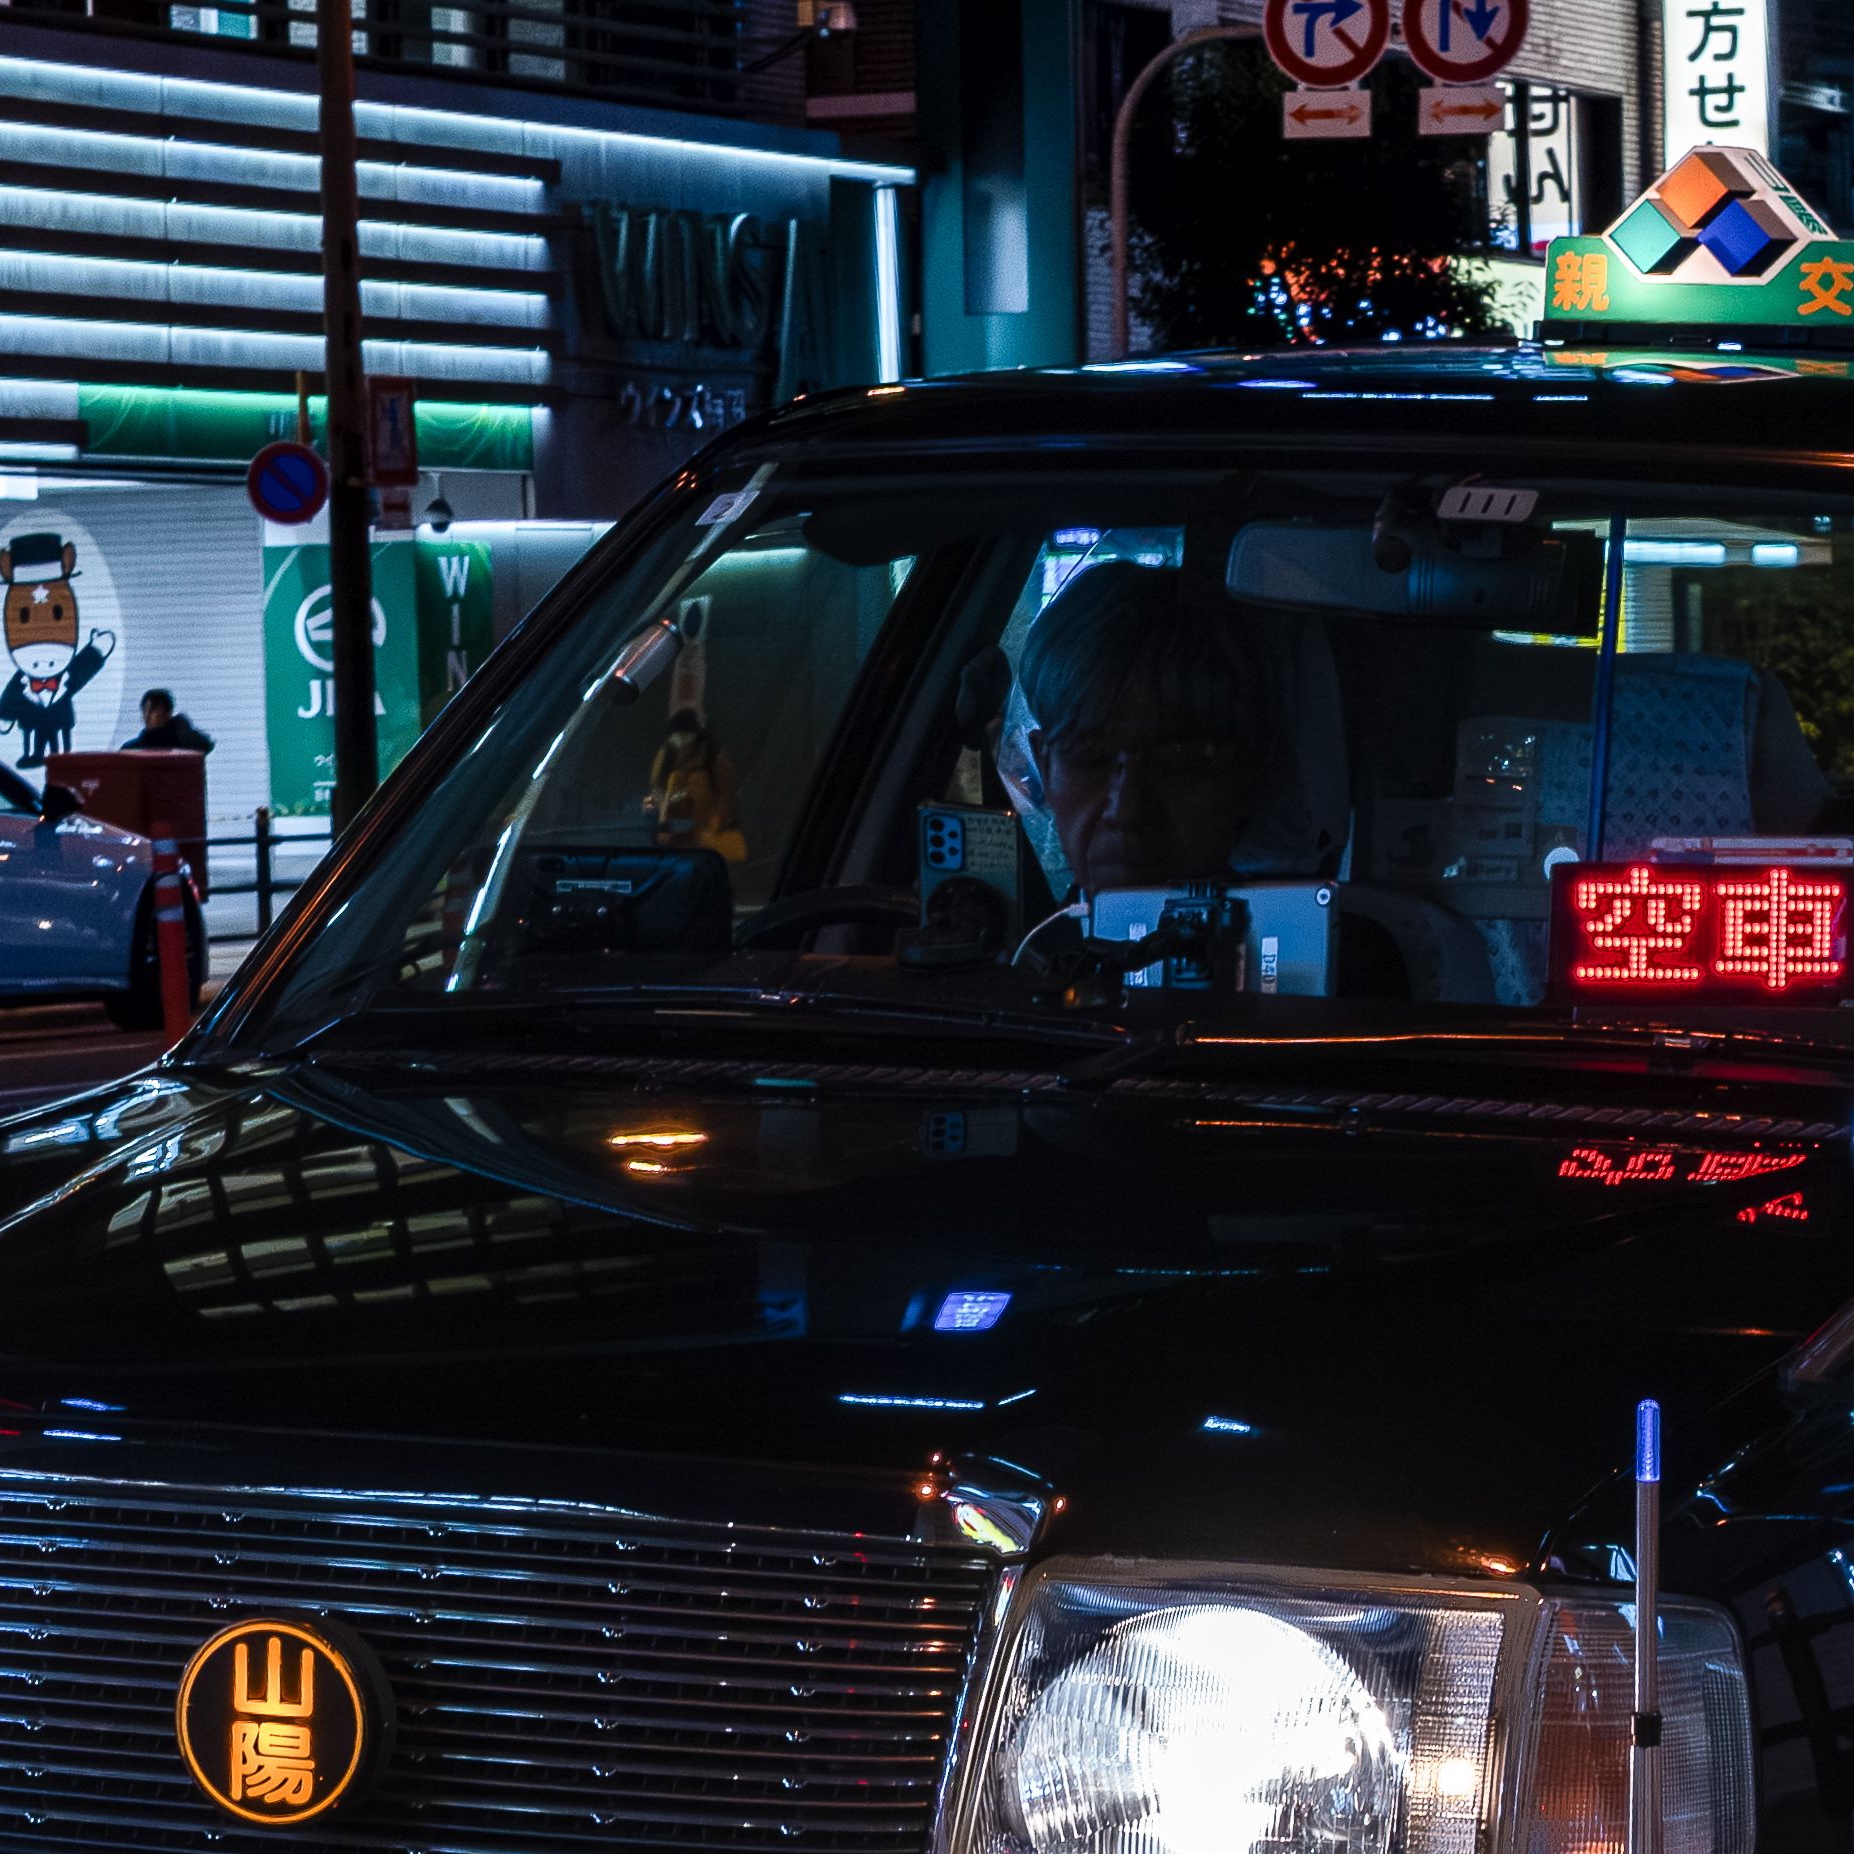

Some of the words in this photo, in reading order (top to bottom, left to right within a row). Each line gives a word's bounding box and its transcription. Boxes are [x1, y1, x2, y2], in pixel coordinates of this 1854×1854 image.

[1686, 1, 1745, 145] 方せ
[1574, 865, 1844, 990] 空車
[229, 1636, 315, 1806] 山陽
